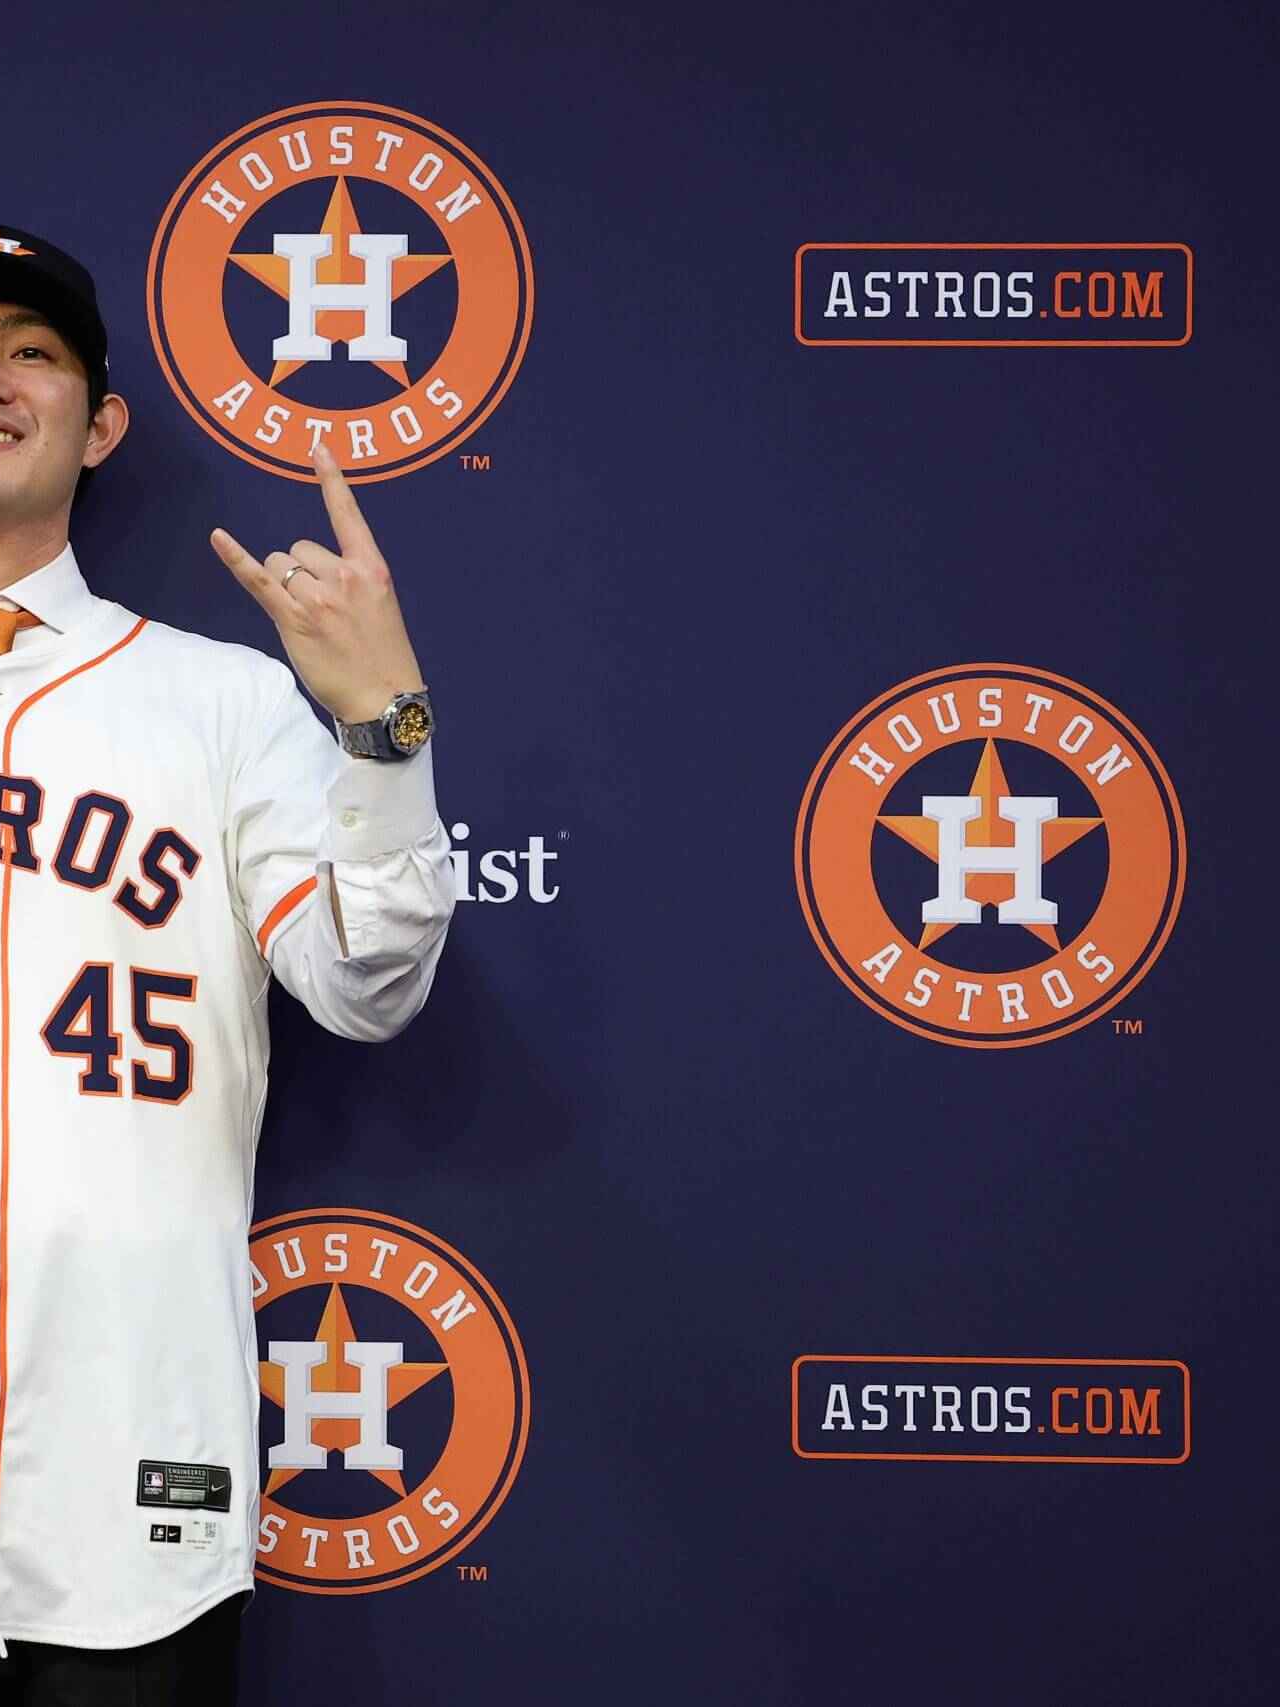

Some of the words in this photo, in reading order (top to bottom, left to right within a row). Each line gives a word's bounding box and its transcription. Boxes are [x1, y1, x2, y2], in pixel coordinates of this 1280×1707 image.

[200, 126, 482, 224] HOUSTON
[272, 233, 409, 362] H
[823, 271, 1164, 318] ASTROS.COM
[212, 377, 463, 460] ASTROS
[459, 455, 490, 470] TM
[848, 688, 1133, 786] HOUSTON
[921, 794, 1059, 925] H
[861, 941, 1115, 1024] ASTROS
[39, 961, 199, 1106] 45
[1111, 1019, 1143, 1035] TM
[250, 1233, 477, 1332] OUSTON
[268, 1340, 404, 1471] H
[821, 1384, 1162, 1436] ASTROS.COM
[256, 1487, 460, 1570] STROS
[456, 1566, 488, 1581] TM
